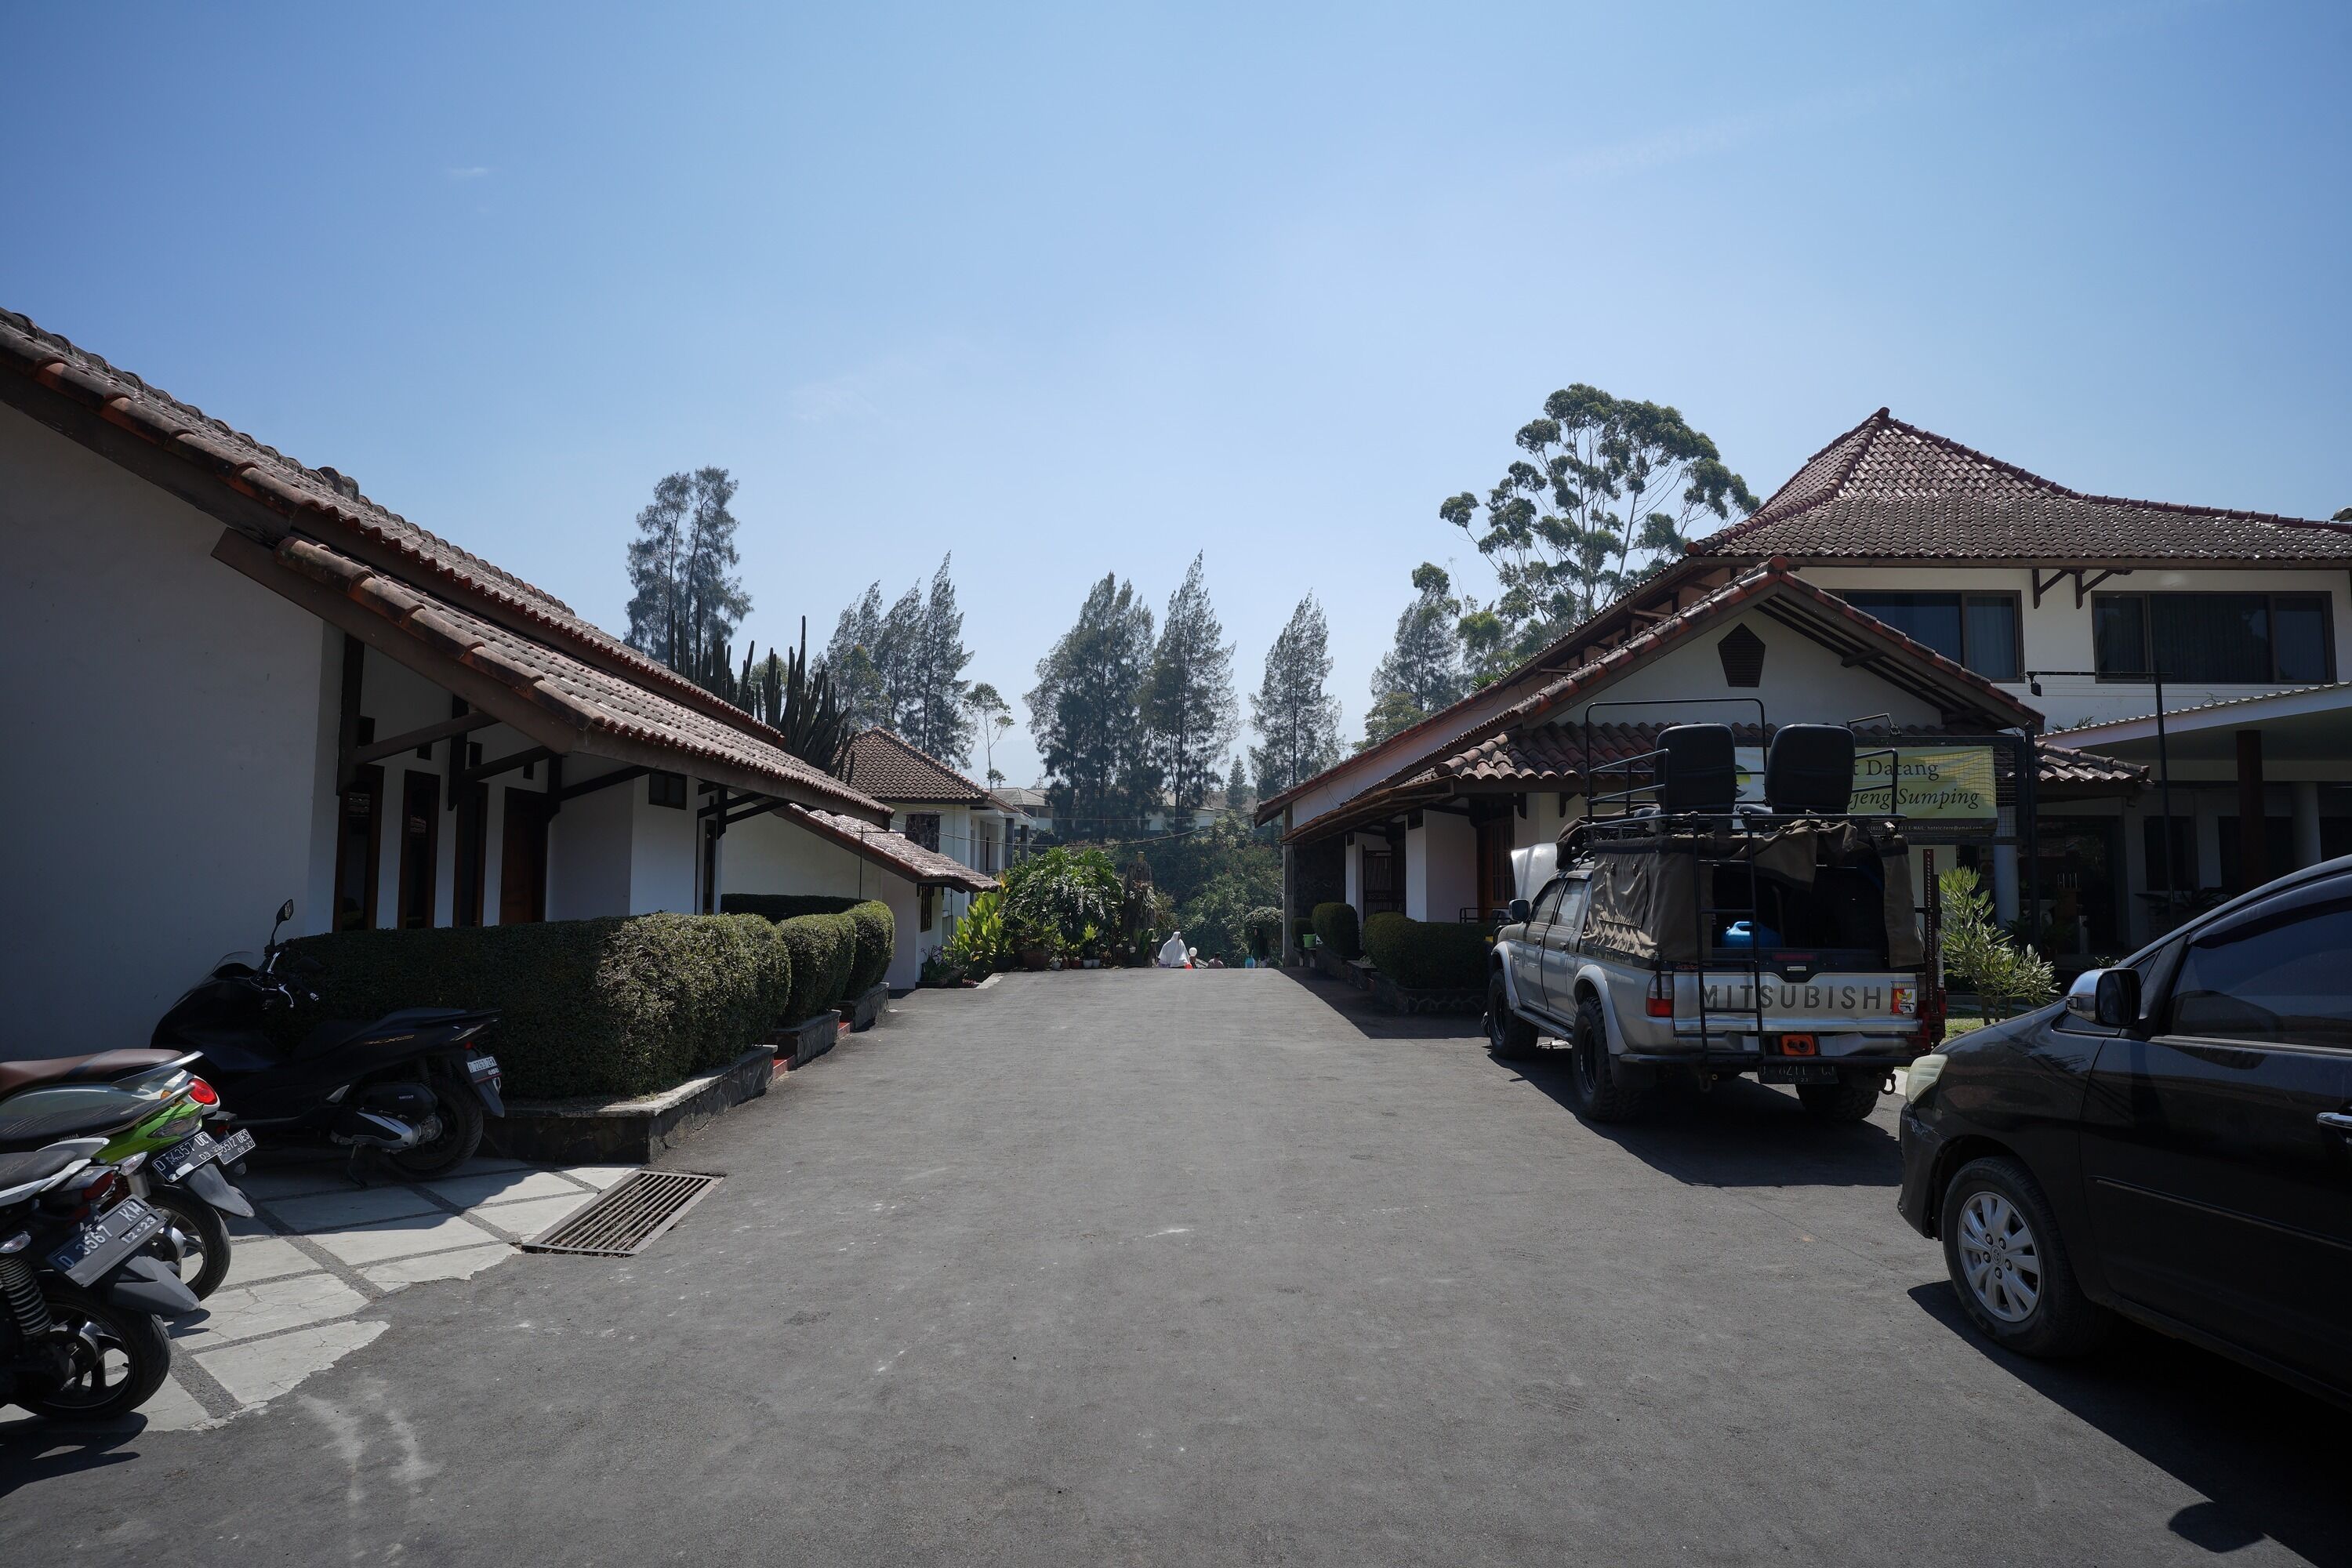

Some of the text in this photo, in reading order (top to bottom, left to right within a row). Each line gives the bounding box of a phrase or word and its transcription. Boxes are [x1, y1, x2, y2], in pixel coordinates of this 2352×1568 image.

[1866, 759, 1940, 782] Datang
[1849, 788, 1980, 810] jeng Sumping
[1703, 985, 1882, 1010] MITSUBISH
[236, 1131, 250, 1143] UES
[155, 1160, 166, 1171] D
[57, 1200, 145, 1269] D 3567 KM
